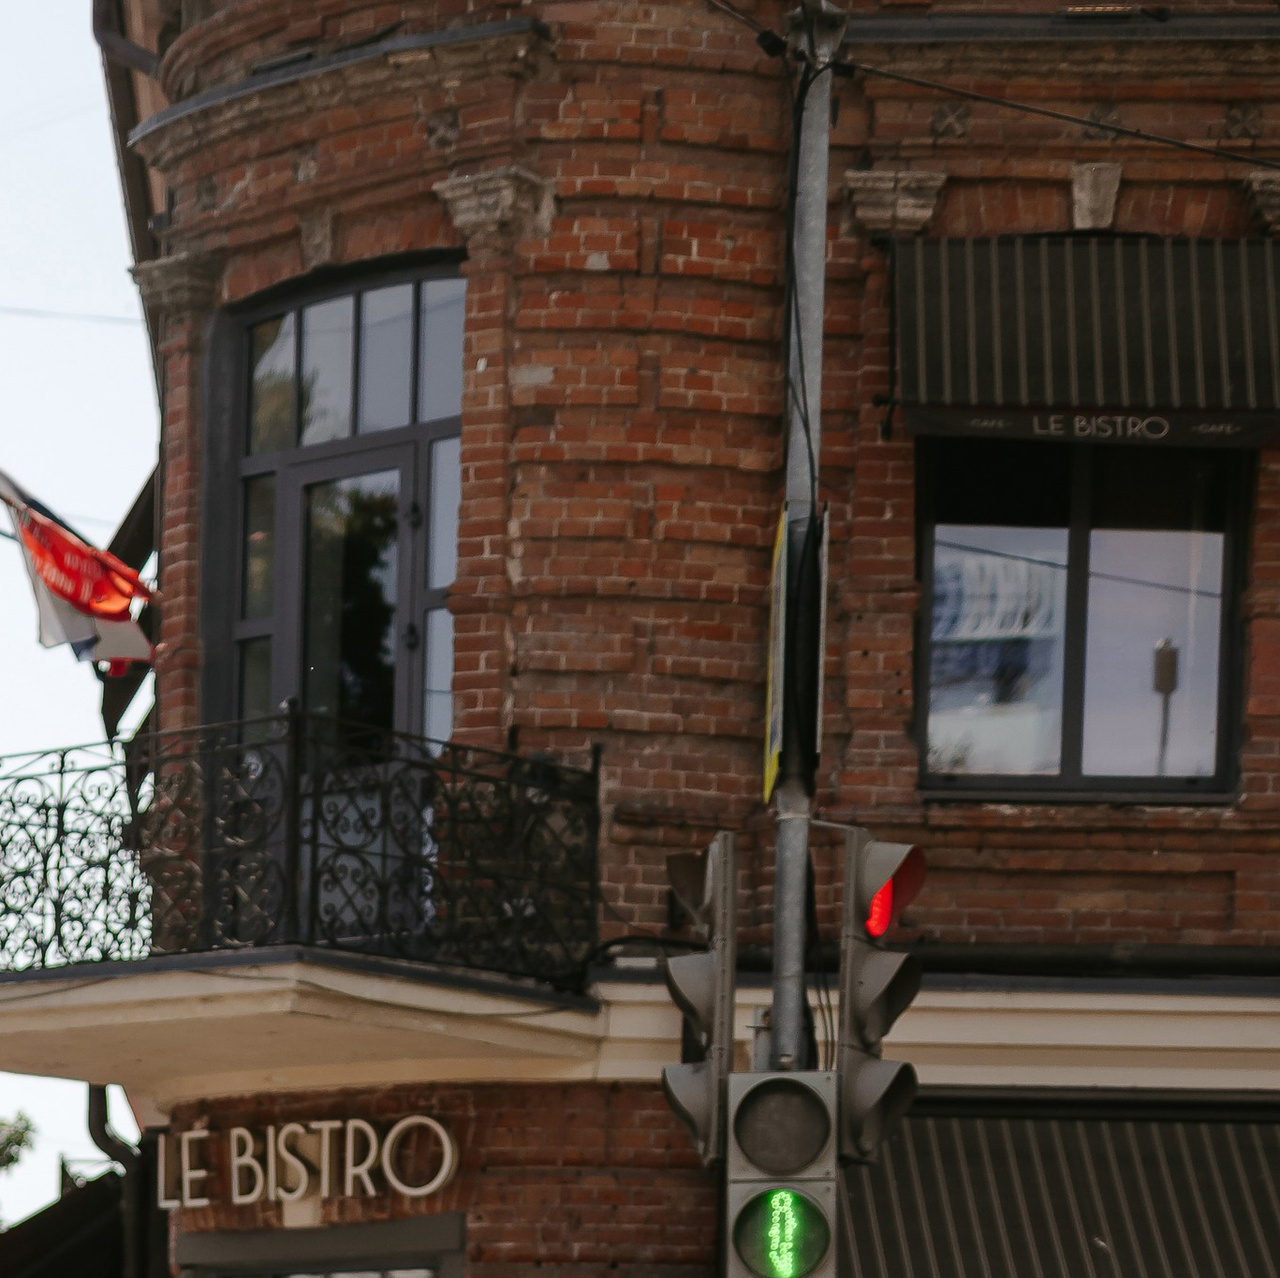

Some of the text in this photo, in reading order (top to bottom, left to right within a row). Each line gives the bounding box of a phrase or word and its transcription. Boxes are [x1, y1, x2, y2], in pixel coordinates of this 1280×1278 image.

[1032, 415, 1065, 436] LE
[1073, 415, 1170, 439] BISTRO
[157, 1114, 453, 1210] LE BISTRO
